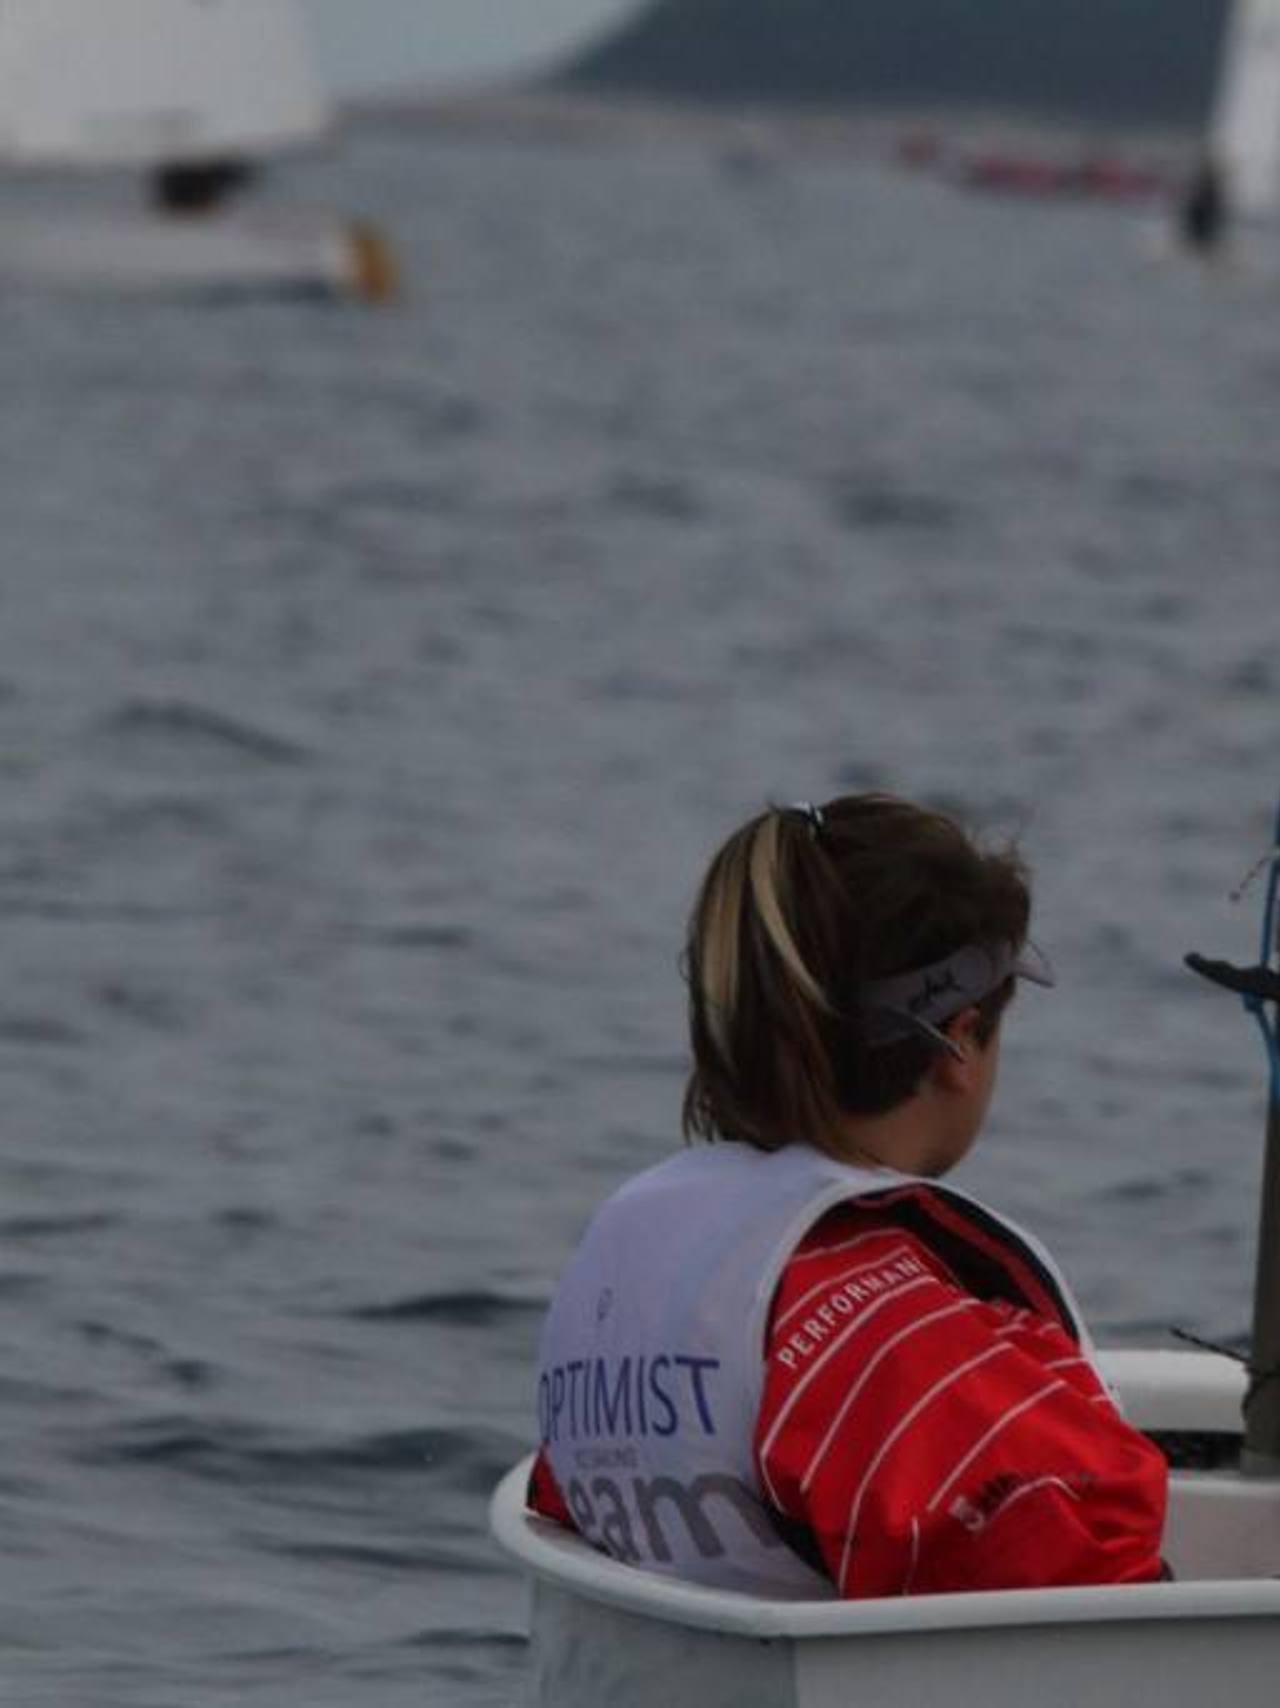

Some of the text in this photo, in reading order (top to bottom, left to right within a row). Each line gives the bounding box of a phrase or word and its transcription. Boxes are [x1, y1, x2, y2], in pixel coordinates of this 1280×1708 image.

[774, 1253, 925, 1370] PERFORMAN
[538, 1354, 721, 1442] OPTIMIST
[568, 1473, 783, 1562] eam
